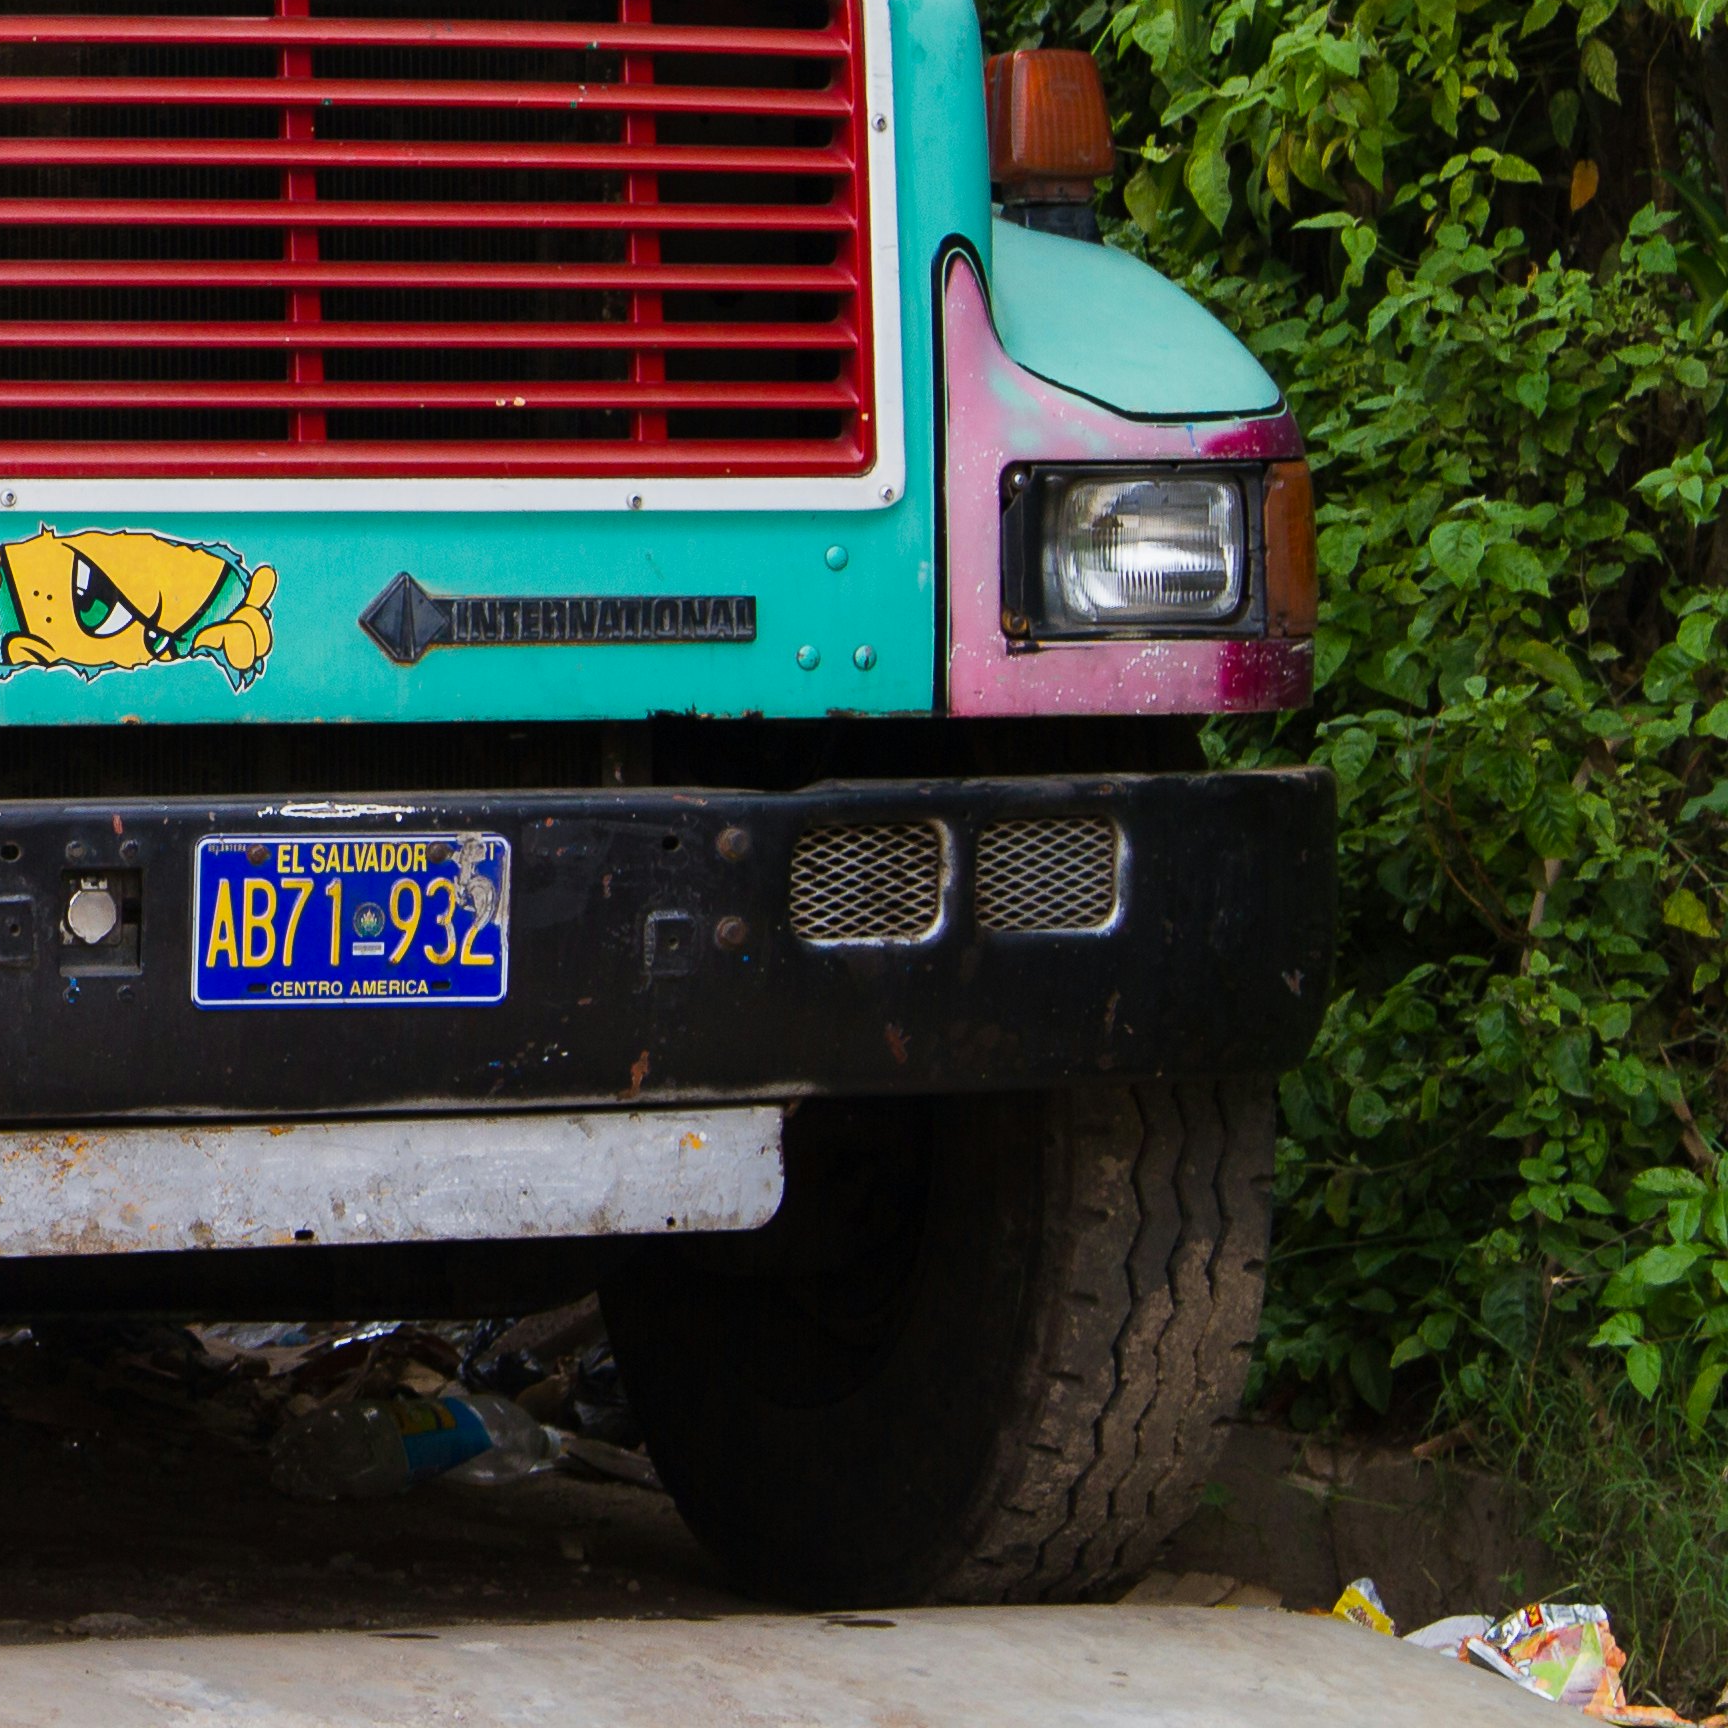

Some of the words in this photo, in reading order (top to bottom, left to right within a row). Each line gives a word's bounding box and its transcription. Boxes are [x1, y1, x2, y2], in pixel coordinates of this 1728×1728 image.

[451, 597, 756, 640] INTERNATIONAL
[277, 844, 305, 874] EL
[311, 843, 428, 873] SALVADOR
[270, 981, 344, 997] CENTRO
[350, 980, 429, 996] AMERICA
